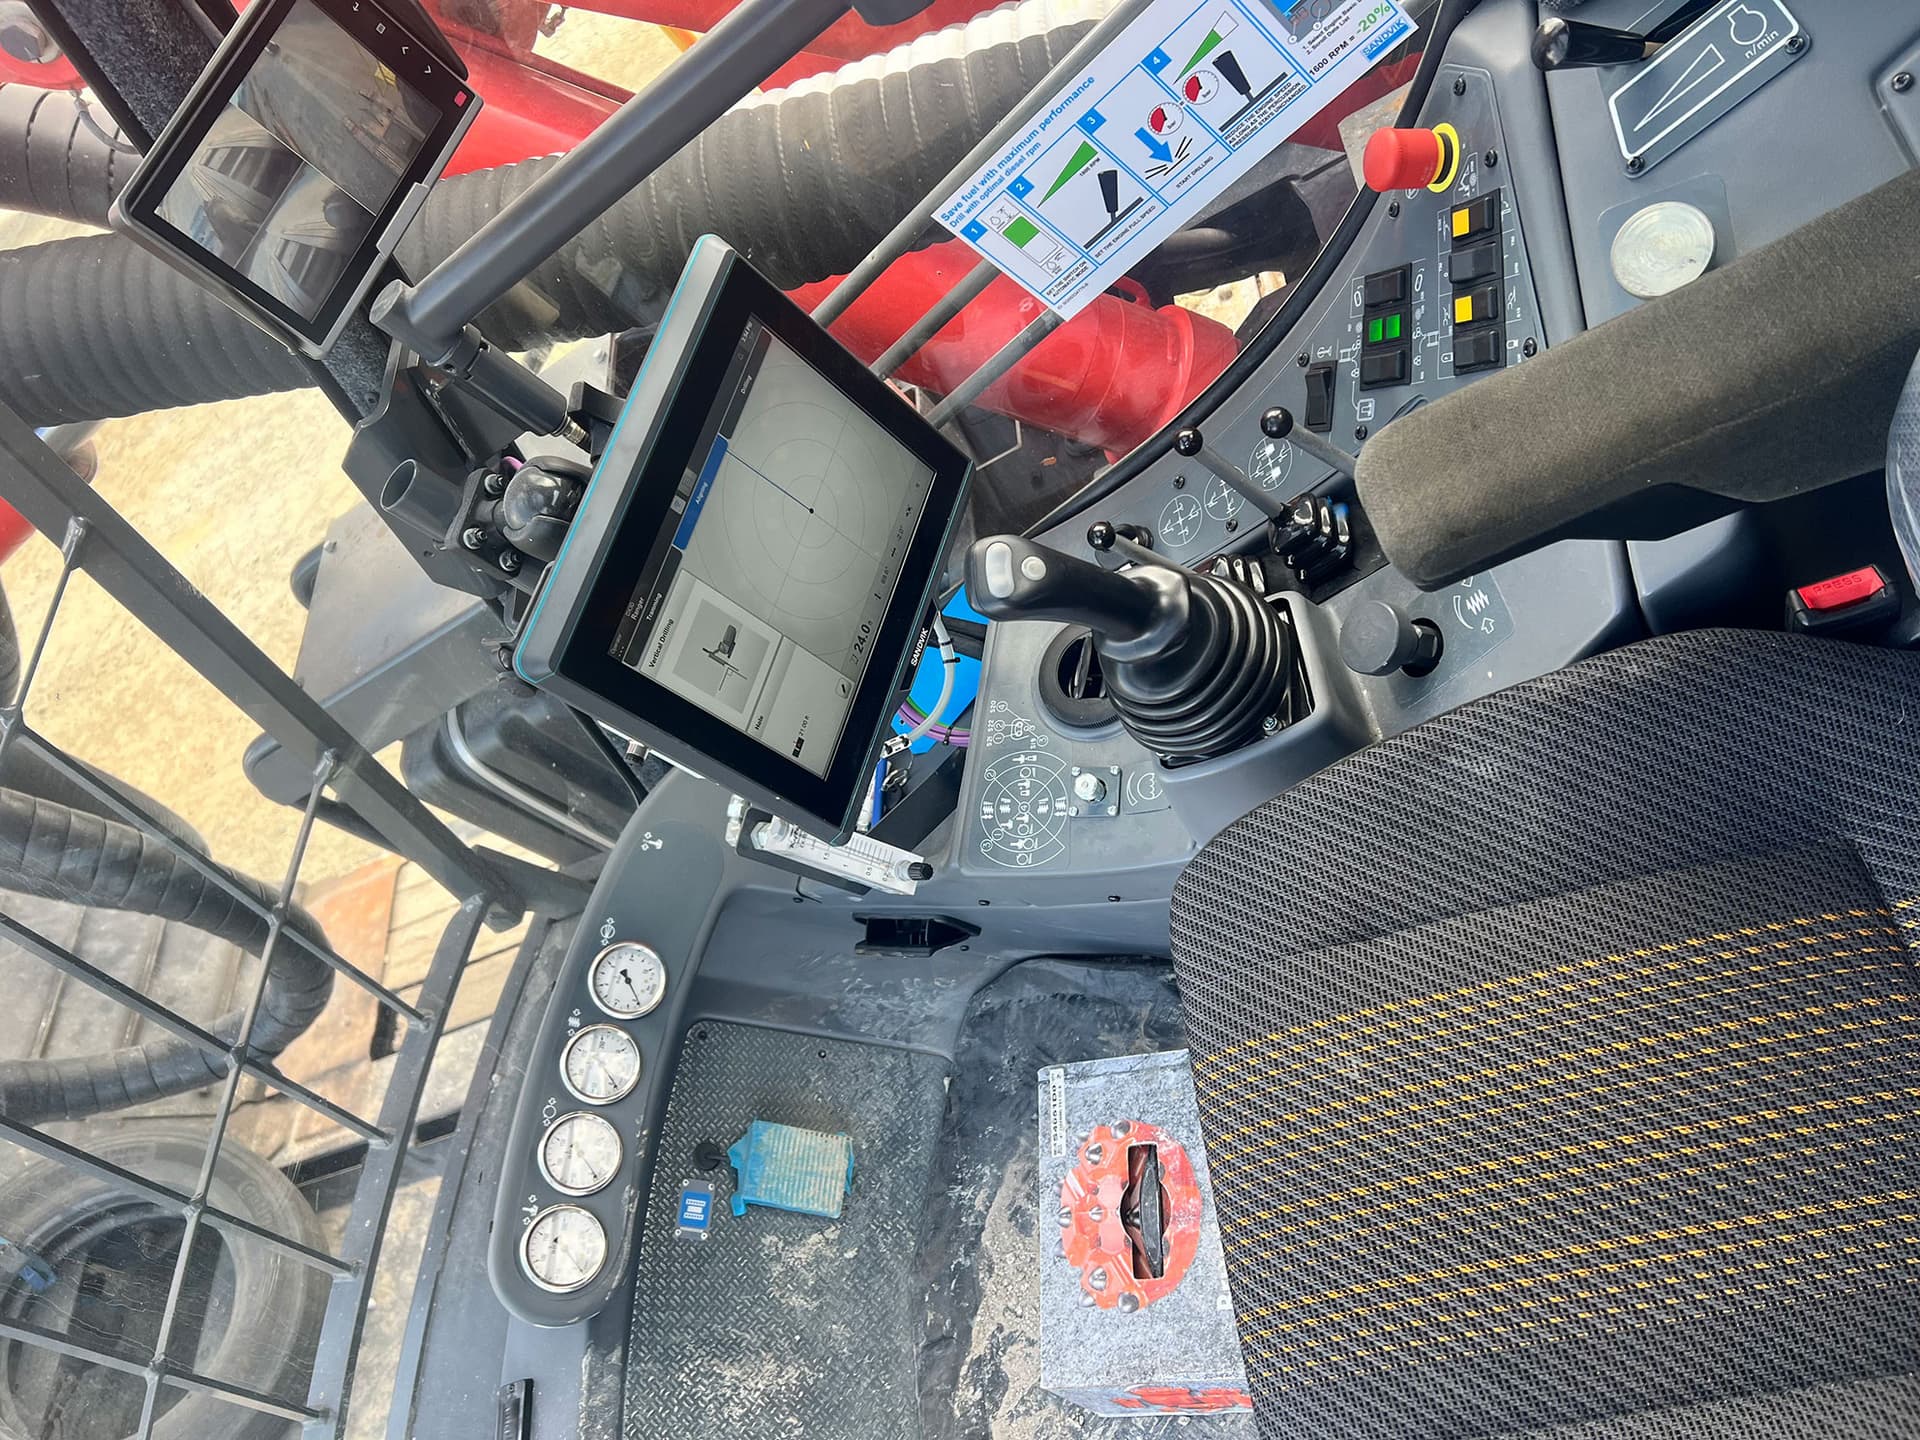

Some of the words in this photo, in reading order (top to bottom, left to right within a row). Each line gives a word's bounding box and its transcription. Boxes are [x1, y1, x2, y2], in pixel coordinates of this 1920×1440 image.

[1307, 30, 1324, 45] Select
[1323, 14, 1343, 32] Engine
[1308, 57, 1329, 76] 1600
[1327, 39, 1349, 59] RPM
[1352, 1, 1391, 36] -20%
[1311, 35, 1327, 50] Scroll
[1326, 24, 1340, 37] Data
[1338, 15, 1350, 26] List
[1361, 18, 1405, 56] SANDVIK
[1743, 28, 1780, 59] n/min
[1086, 115, 1096, 125] 3
[1223, 122, 1245, 141] REDUCE
[1243, 112, 1255, 124] THE
[1254, 96, 1274, 115] ENGINE
[1273, 81, 1292, 98] SPEED
[1227, 136, 1237, 145] AS
[1235, 124, 1251, 138] LONG
[1249, 117, 1258, 126] AS
[1257, 109, 1269, 120] THE
[1267, 81, 1301, 111] PERCUSSION
[1231, 124, 1259, 149] PRESSURE
[1257, 110, 1275, 127] STAYS
[940, 199, 964, 222] Save
[960, 183, 980, 203] fuel
[976, 166, 998, 188] with
[995, 127, 1039, 170] maximum
[1037, 74, 1096, 131] performance
[949, 212, 966, 228] Drill
[964, 198, 980, 214] with
[978, 174, 1006, 202] optimal
[1003, 154, 1027, 177] diesel
[1024, 140, 1042, 158] rpm
[1015, 181, 1025, 191] 2
[1175, 173, 1192, 189] START
[1190, 154, 1213, 175] DRILLING
[1094, 249, 1104, 258] SET
[1103, 241, 1113, 251] THE
[1111, 227, 1129, 243] ENGINE
[1128, 217, 1141, 229] FULL
[1052, 276, 1075, 297] AUTOMATIC
[1053, 280, 1063, 289] THE
[1062, 264, 1081, 281] SWITCH
[739, 374, 753, 394] Drilling
[694, 481, 709, 504] Aligning
[1812, 575, 1862, 592] PRESS
[630, 596, 646, 620] Ranger
[645, 591, 662, 621] Tramming
[647, 641, 663, 669] Vertical
[658, 617, 675, 643] Drilling
[853, 623, 871, 653] 24.0
[910, 627, 928, 665] SANDVIK
[754, 714, 764, 730] Hole
